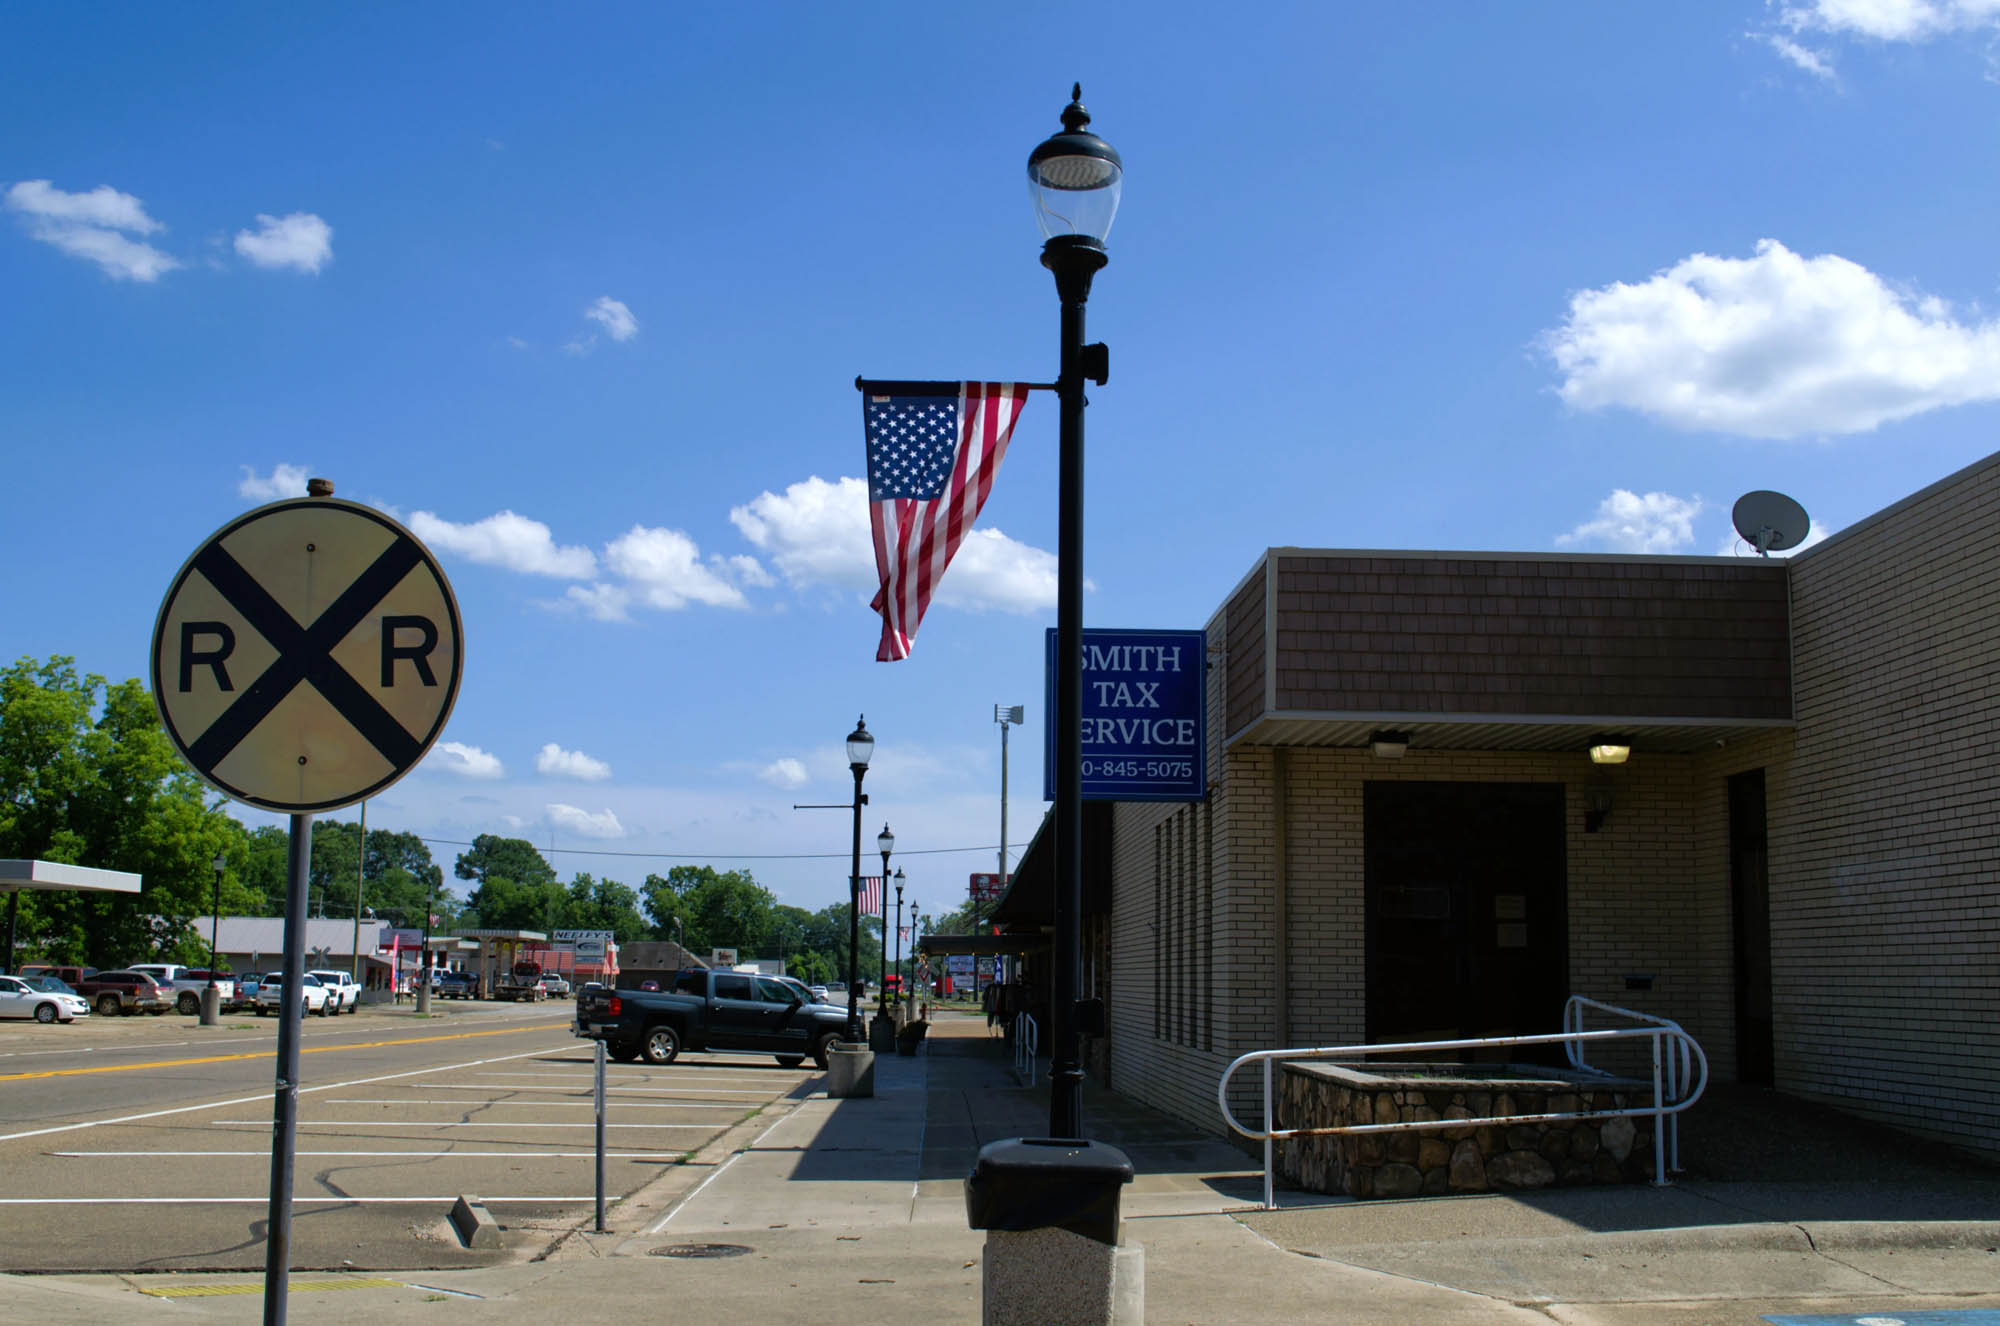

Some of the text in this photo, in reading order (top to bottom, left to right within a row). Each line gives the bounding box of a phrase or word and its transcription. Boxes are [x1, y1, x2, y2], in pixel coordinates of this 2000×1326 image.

[179, 615, 439, 693] R R
[1093, 681, 1161, 708] TAX
[1081, 718, 1195, 745] ERVICE
[1082, 760, 1193, 777] 0-845-5075
